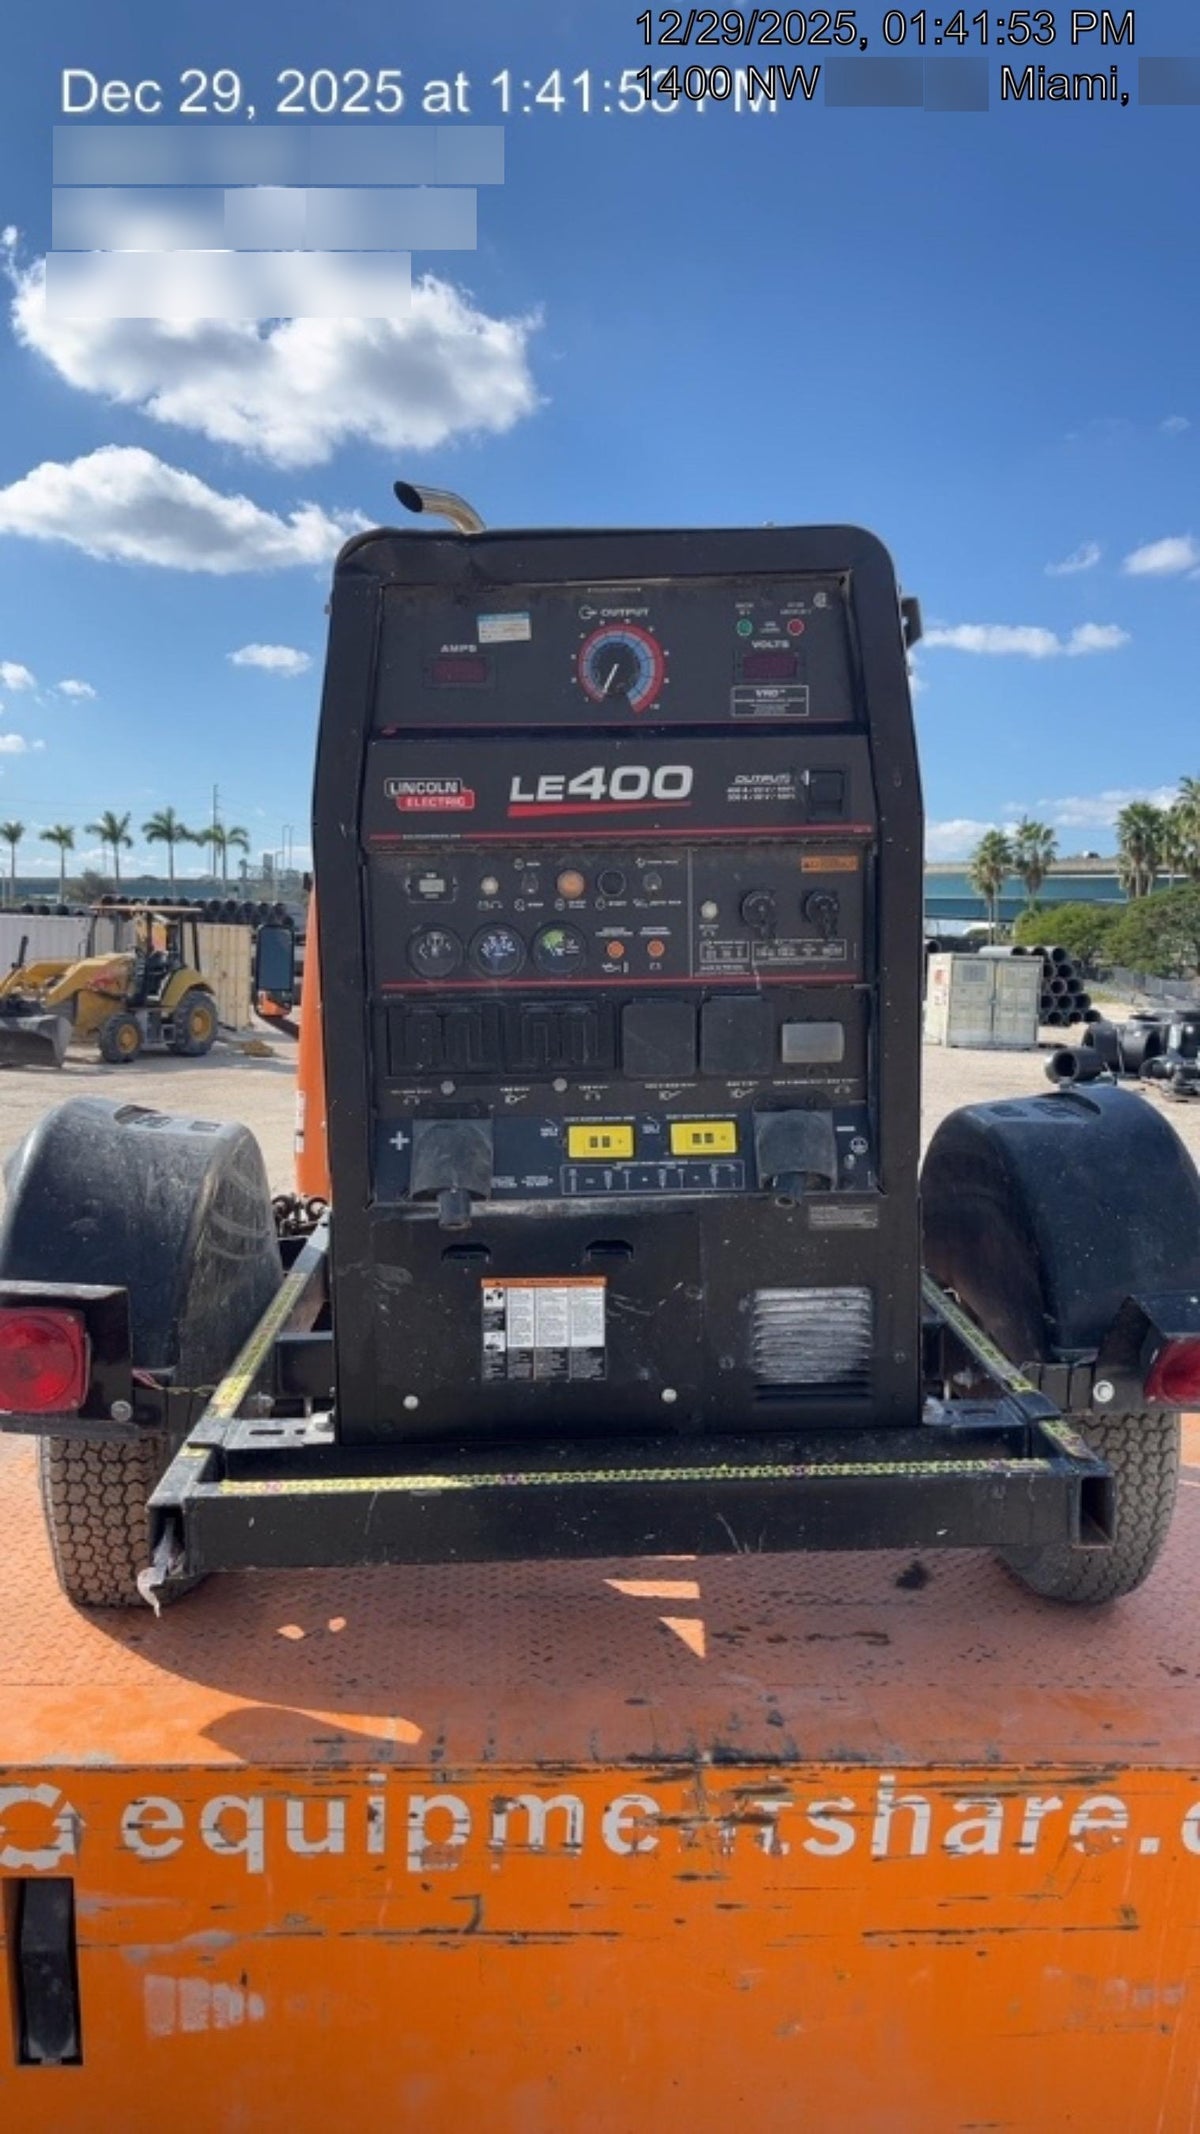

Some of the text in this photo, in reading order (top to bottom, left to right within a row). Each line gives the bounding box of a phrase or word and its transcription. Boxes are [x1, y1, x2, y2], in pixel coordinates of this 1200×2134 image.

[600, 608, 649, 618] OUTPUT
[441, 644, 477, 653] AMPS
[752, 640, 790, 648] VOLTS
[390, 781, 458, 795] LINCOLN
[509, 765, 694, 802] LE400
[406, 796, 466, 808] ELECTRIC
